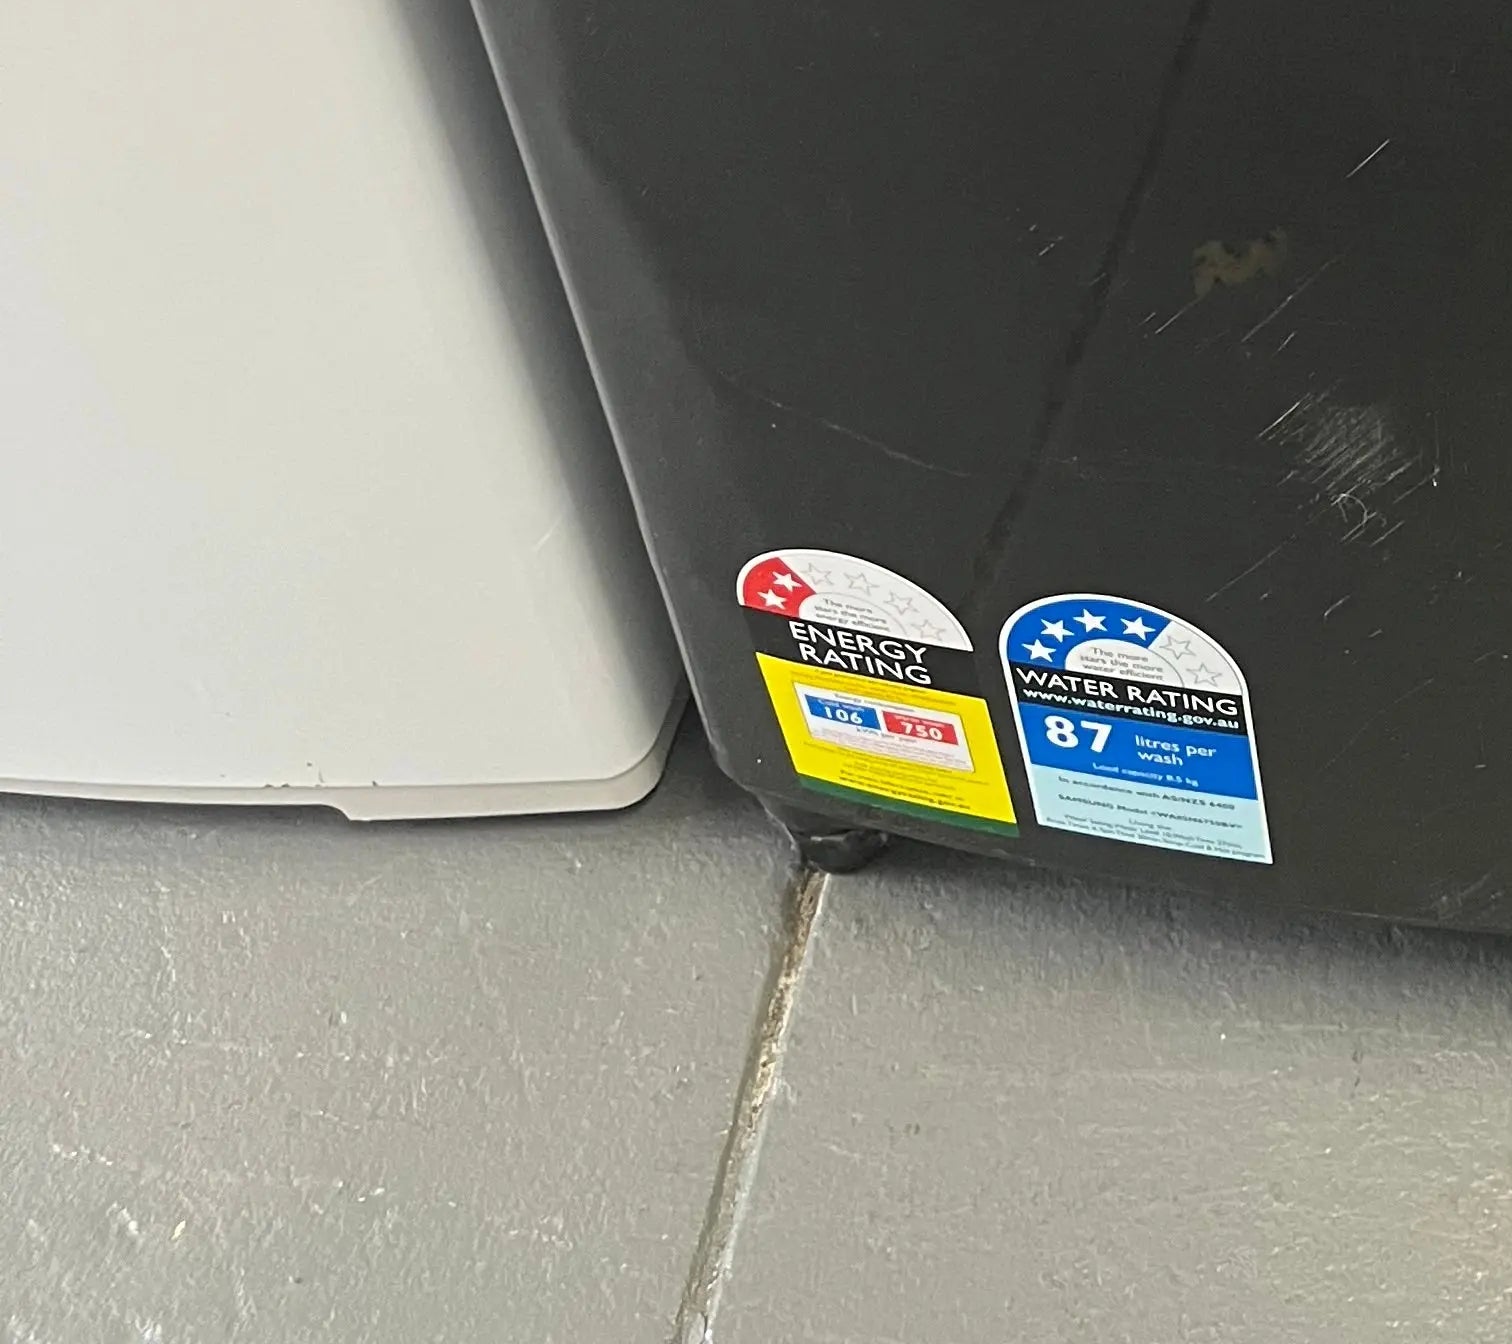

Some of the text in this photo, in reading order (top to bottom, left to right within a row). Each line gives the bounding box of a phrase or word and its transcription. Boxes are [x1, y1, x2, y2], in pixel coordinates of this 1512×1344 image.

[788, 621, 927, 664] ENERGY
[799, 643, 932, 685] RATING
[1016, 666, 1239, 717] WATER RATING
[1022, 687, 1240, 730] www.waterrating.gov.au
[825, 706, 863, 725] 106
[901, 721, 943, 741] 750
[1044, 715, 1113, 754] 87
[1135, 734, 1217, 759] litres per
[1137, 748, 1184, 767] wash
